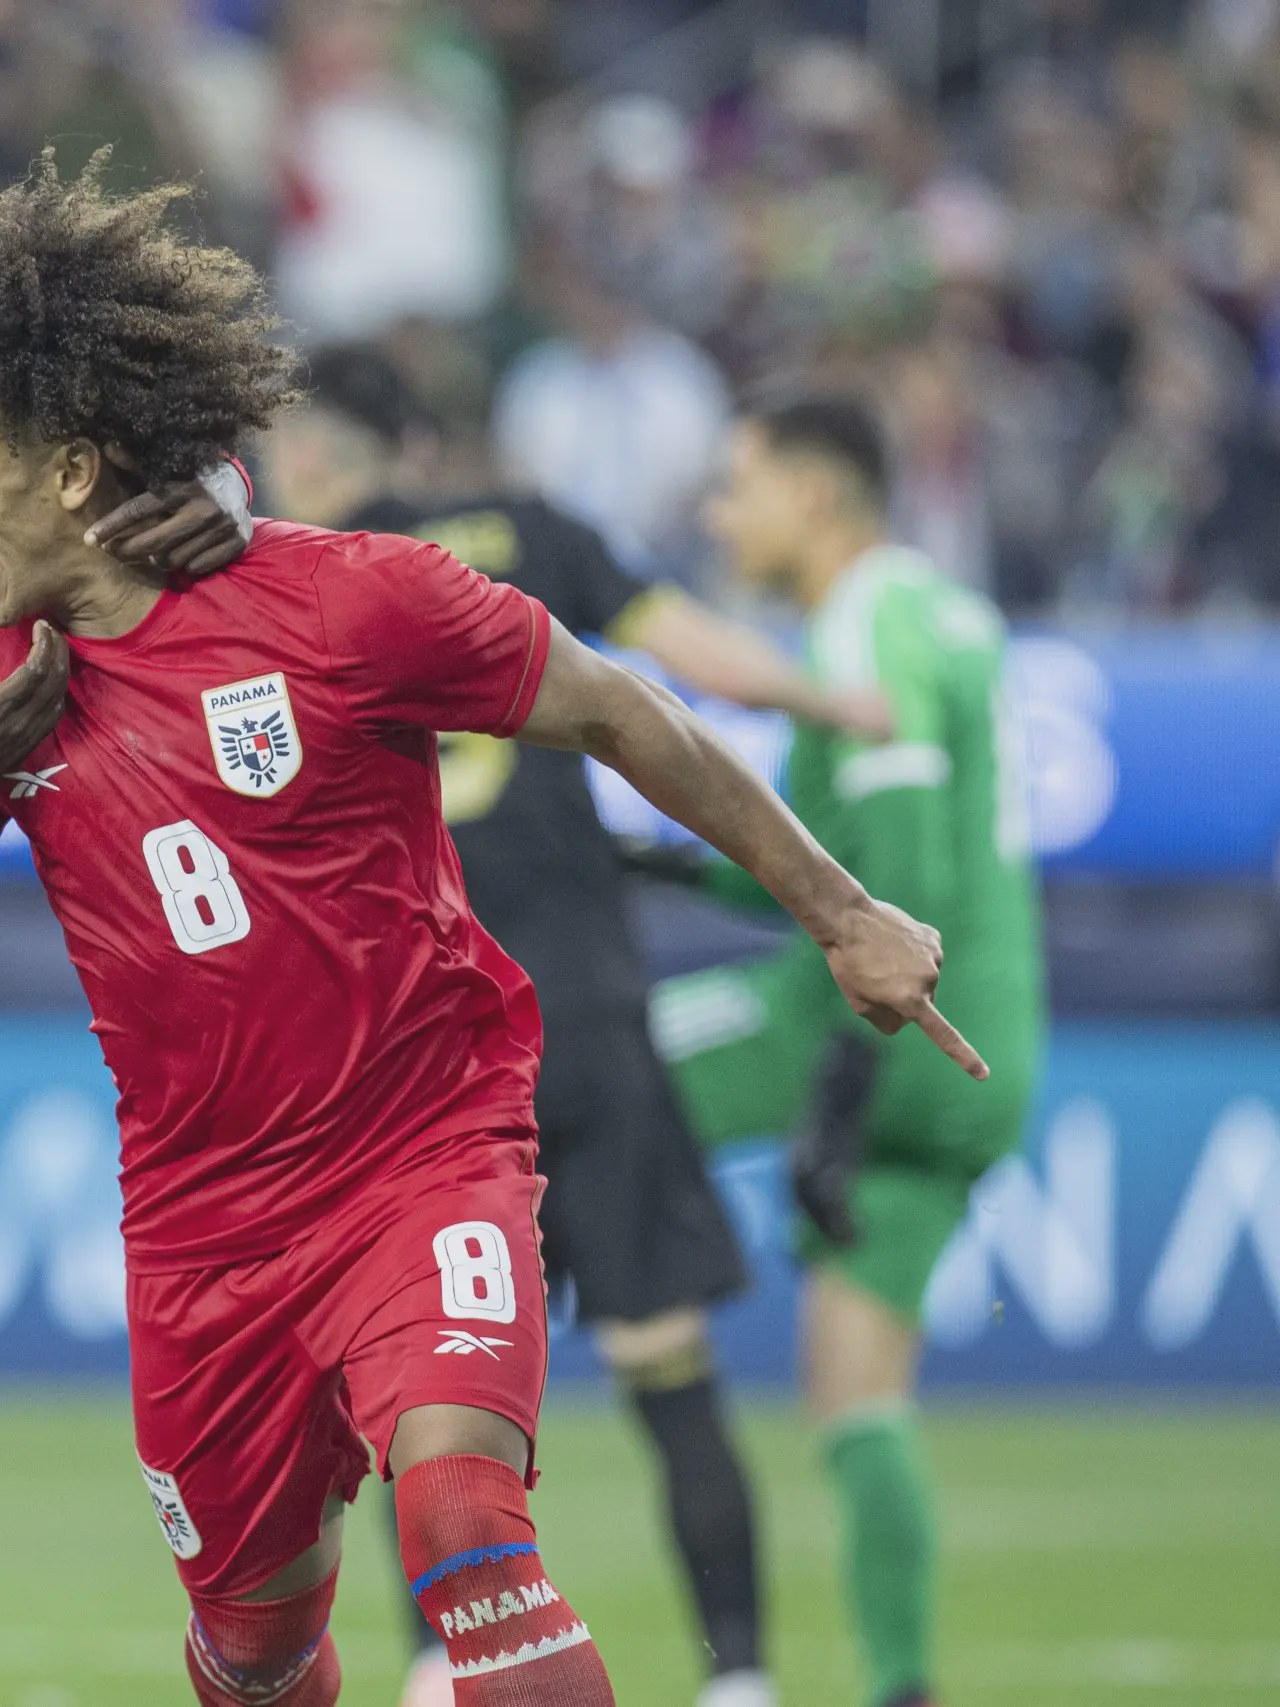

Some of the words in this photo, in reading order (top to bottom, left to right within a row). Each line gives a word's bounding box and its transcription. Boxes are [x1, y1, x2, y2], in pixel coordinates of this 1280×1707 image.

[210, 681, 277, 709] PANAMÁ
[142, 818, 251, 955] 8
[432, 1220, 516, 1324] 8
[440, 1578, 559, 1639] PANAMA
